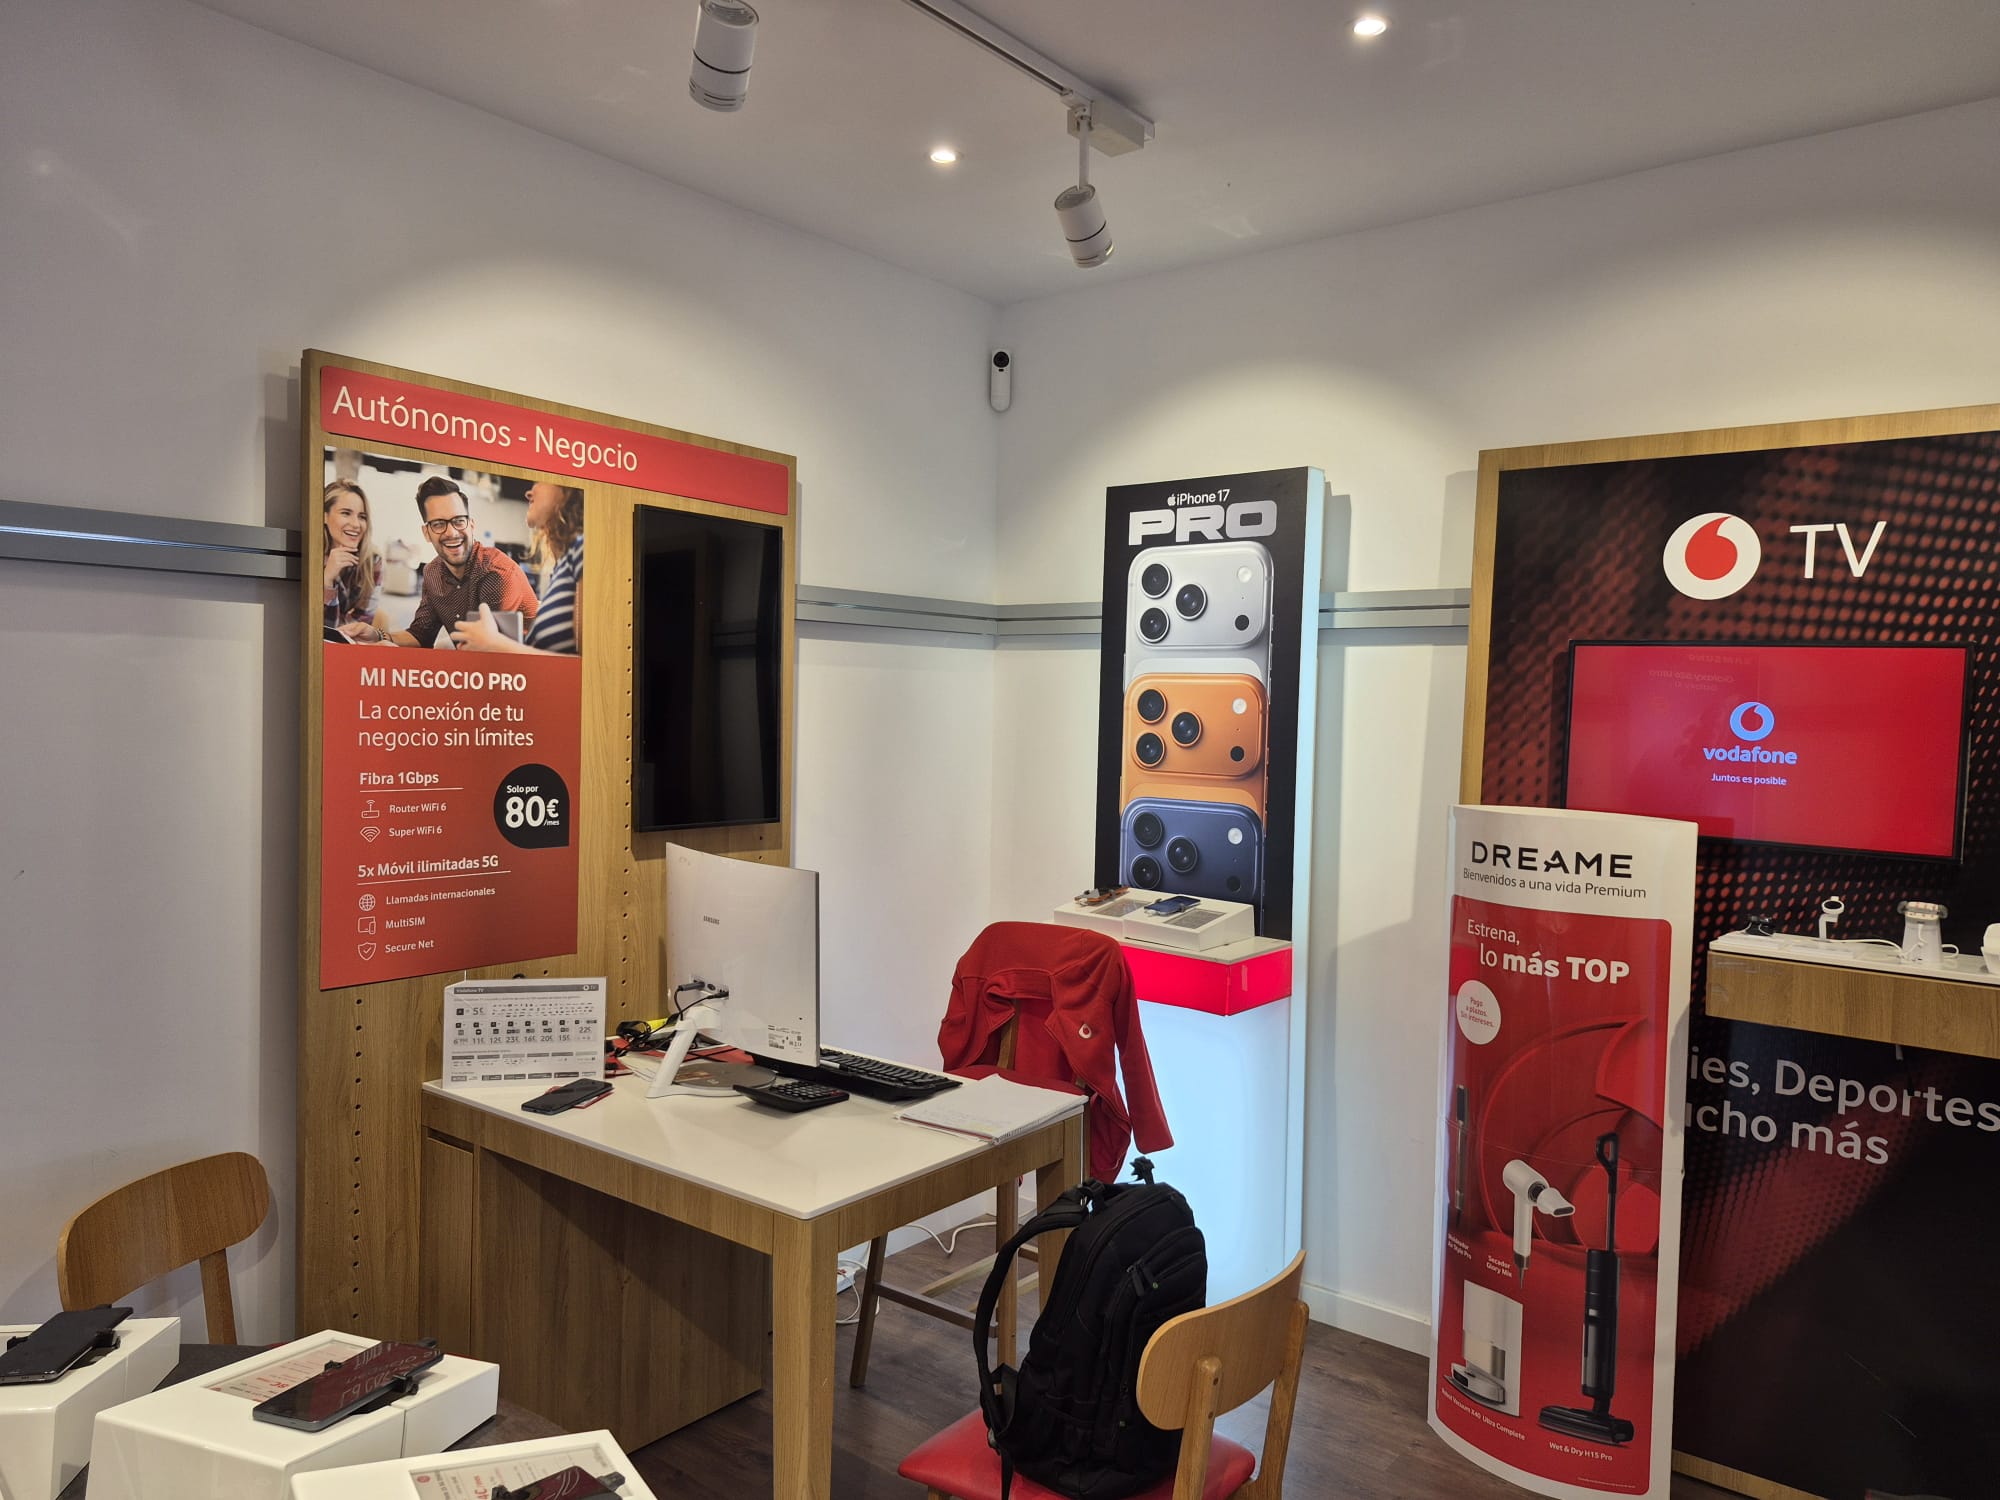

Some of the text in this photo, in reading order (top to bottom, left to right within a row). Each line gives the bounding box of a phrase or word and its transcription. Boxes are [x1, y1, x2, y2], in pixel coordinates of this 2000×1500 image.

[332, 385, 511, 448] Autónomos
[535, 425, 638, 473] Negocio
[1176, 488, 1230, 506] iPhone 17
[1128, 500, 1277, 546] PRO
[1789, 521, 1887, 579] TV
[360, 667, 527, 692] MI NEGOCIO PRO
[359, 700, 524, 722] La conexión de tu
[358, 728, 534, 752] negocio sin límites
[1703, 745, 1798, 765] vodafone
[360, 772, 439, 787] Fibra 1Gbps
[506, 784, 539, 795] Solo por
[1711, 772, 1787, 787] Juntos es posible
[389, 803, 447, 814] Router WiFi 6
[389, 826, 443, 840] Super WiFi 6
[357, 855, 499, 878] 5x Móvil ilimitadas 5G
[1471, 841, 1633, 879] DREAME
[1464, 868, 1517, 888] Bienvenidos
[1529, 881, 1552, 891] una
[1556, 881, 1581, 894] vida
[1585, 883, 1646, 899] Premium
[386, 887, 496, 905] Llamadas internacionales
[385, 917, 425, 929] MultiSIM
[1467, 919, 1520, 945] Estrena,
[385, 940, 434, 953] Secure Net
[1481, 943, 1630, 984] lo más TOP
[1775, 1059, 2000, 1132] Deportes
[1792, 1120, 1889, 1165] más
[1549, 1441, 1613, 1461] Wet & Dry H15 Pro
